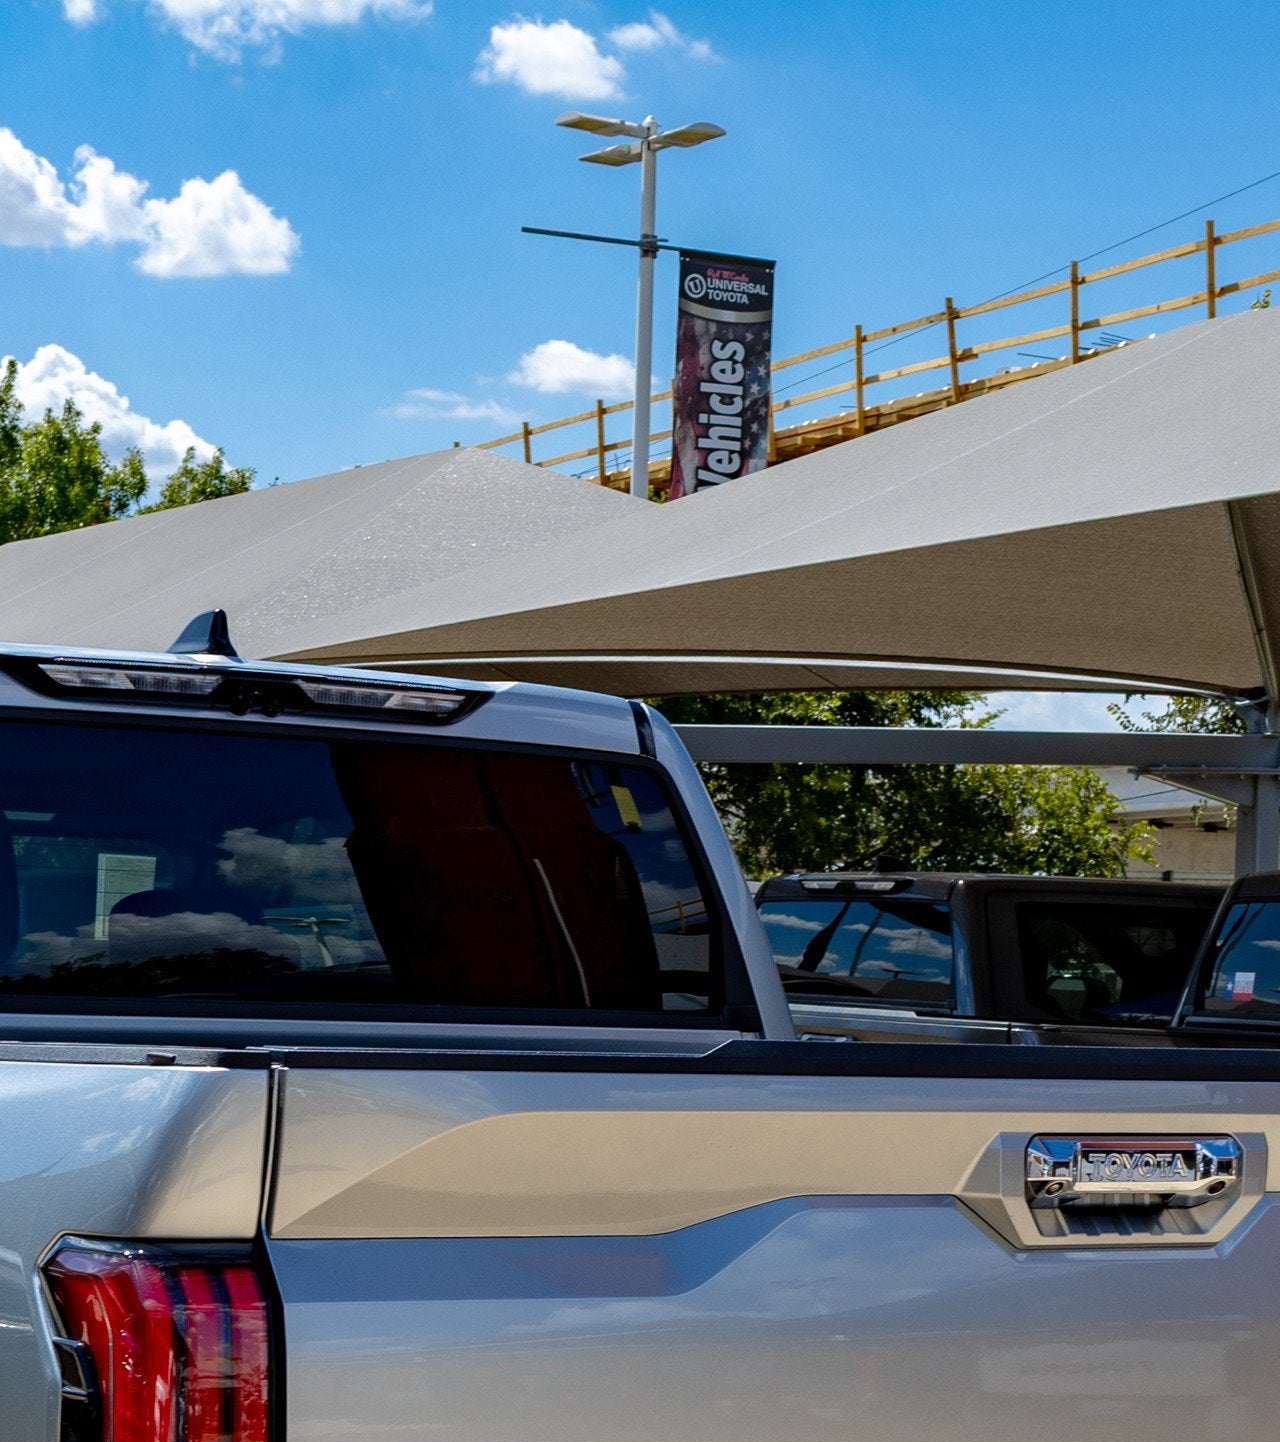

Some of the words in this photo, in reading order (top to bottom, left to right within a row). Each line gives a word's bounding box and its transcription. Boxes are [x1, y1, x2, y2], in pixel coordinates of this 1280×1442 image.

[707, 278, 769, 296] UNIVERSAL
[706, 289, 749, 304] TOYOTA
[1088, 1153, 1188, 1179] TOYOTA
